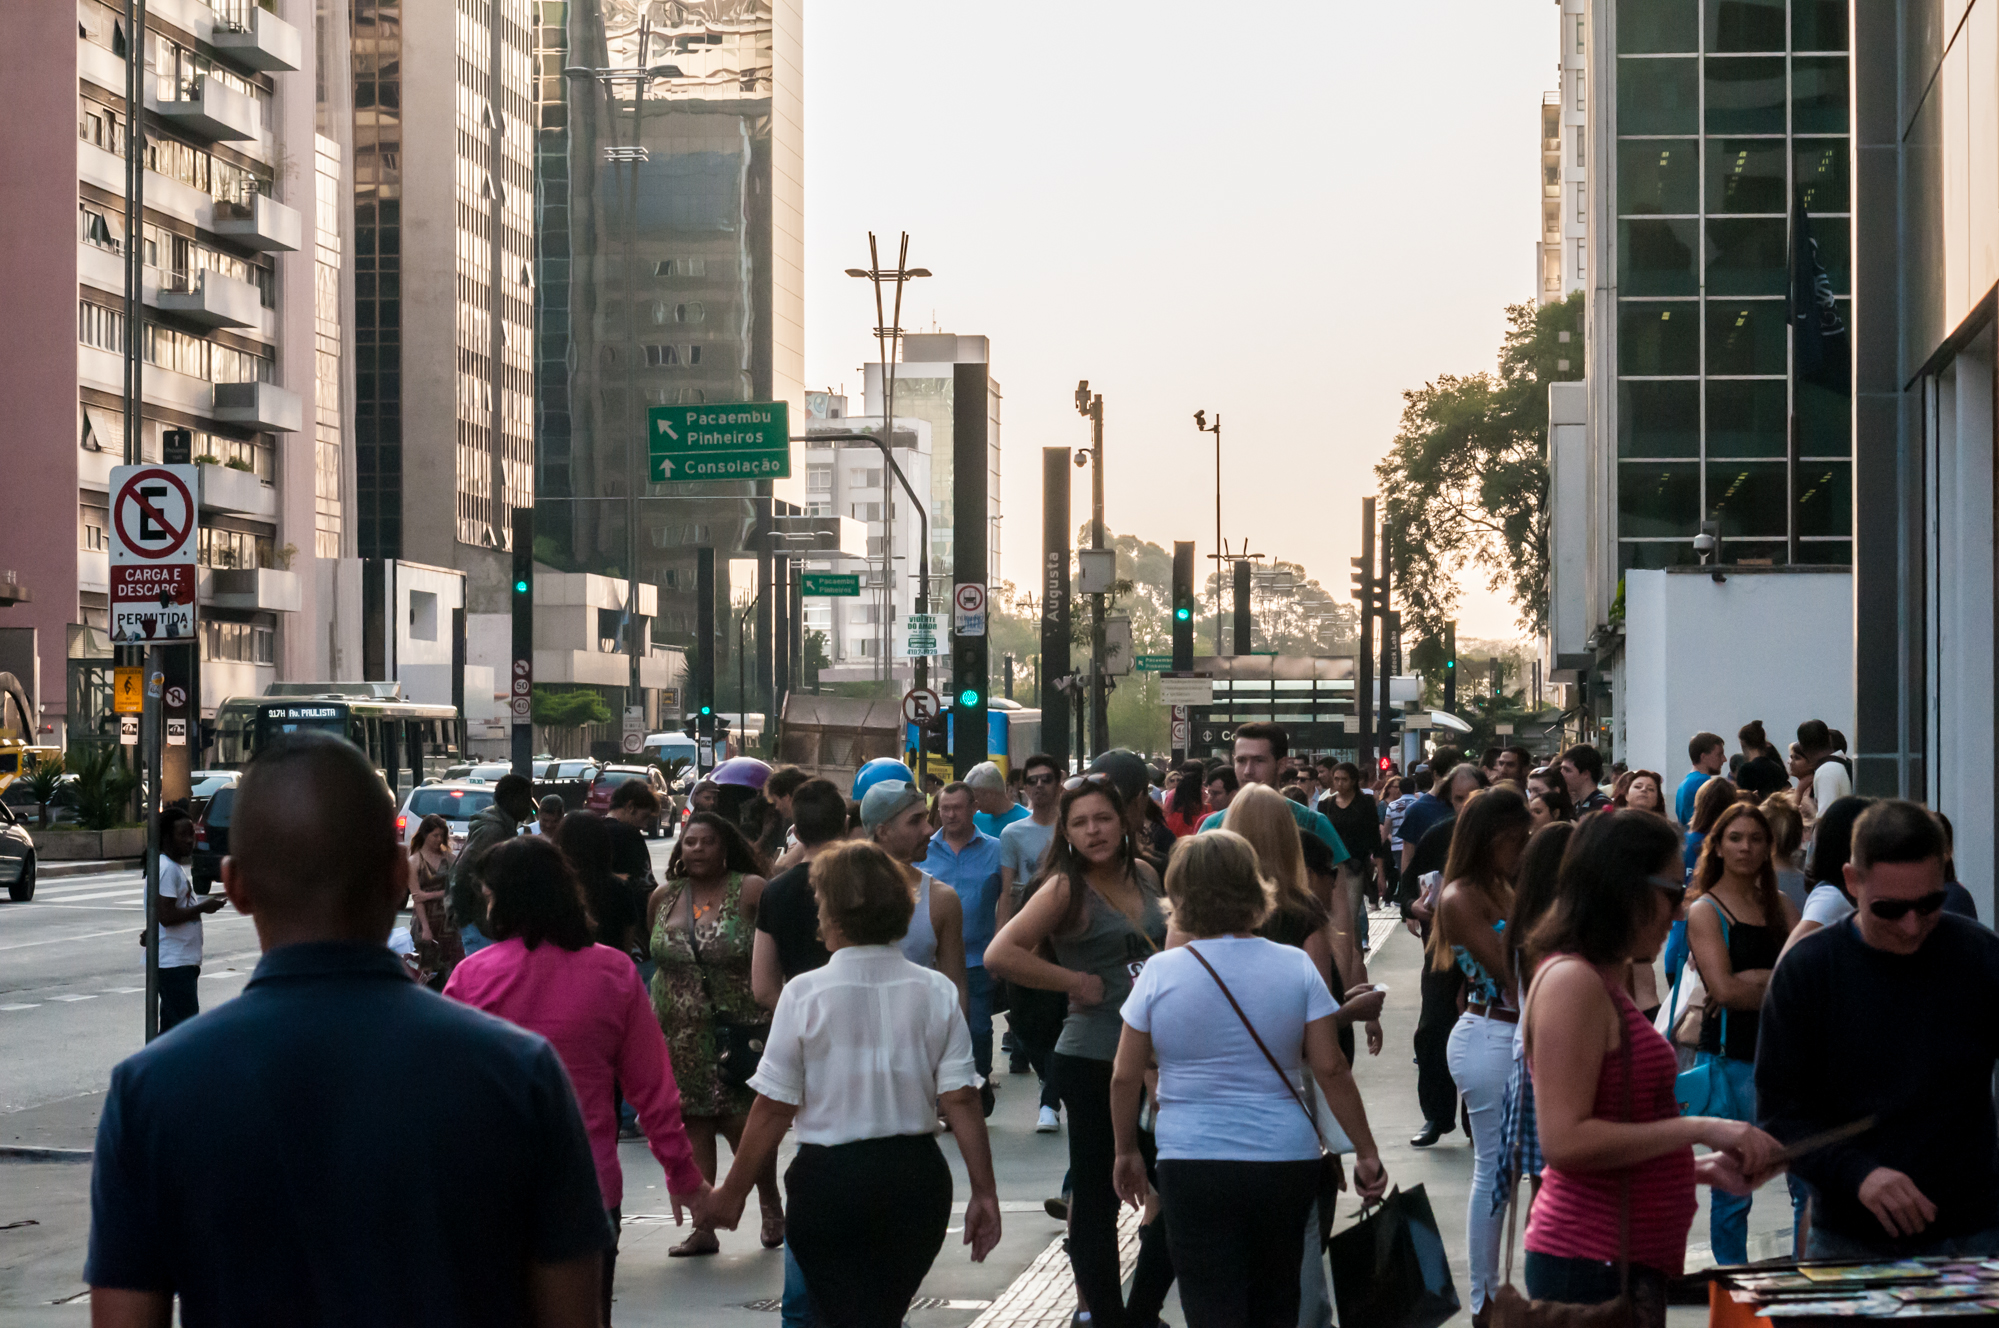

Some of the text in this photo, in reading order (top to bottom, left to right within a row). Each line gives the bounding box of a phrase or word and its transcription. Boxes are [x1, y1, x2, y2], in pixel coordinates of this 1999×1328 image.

[686, 410, 771, 425] Pacaembu
[687, 431, 764, 445] Pinheiros
[685, 458, 780, 474] Consolação
[140, 486, 168, 540] E
[125, 568, 181, 581] CARGA E
[818, 577, 855, 585] Pacaembu
[118, 583, 185, 596] DESCARG
[1046, 552, 1063, 622] Augusta
[117, 612, 188, 625] PERMITIDA
[516, 681, 528, 690] 50
[268, 709, 286, 718] 917H
[301, 708, 336, 717] PAULISTA
[914, 695, 928, 718] E
